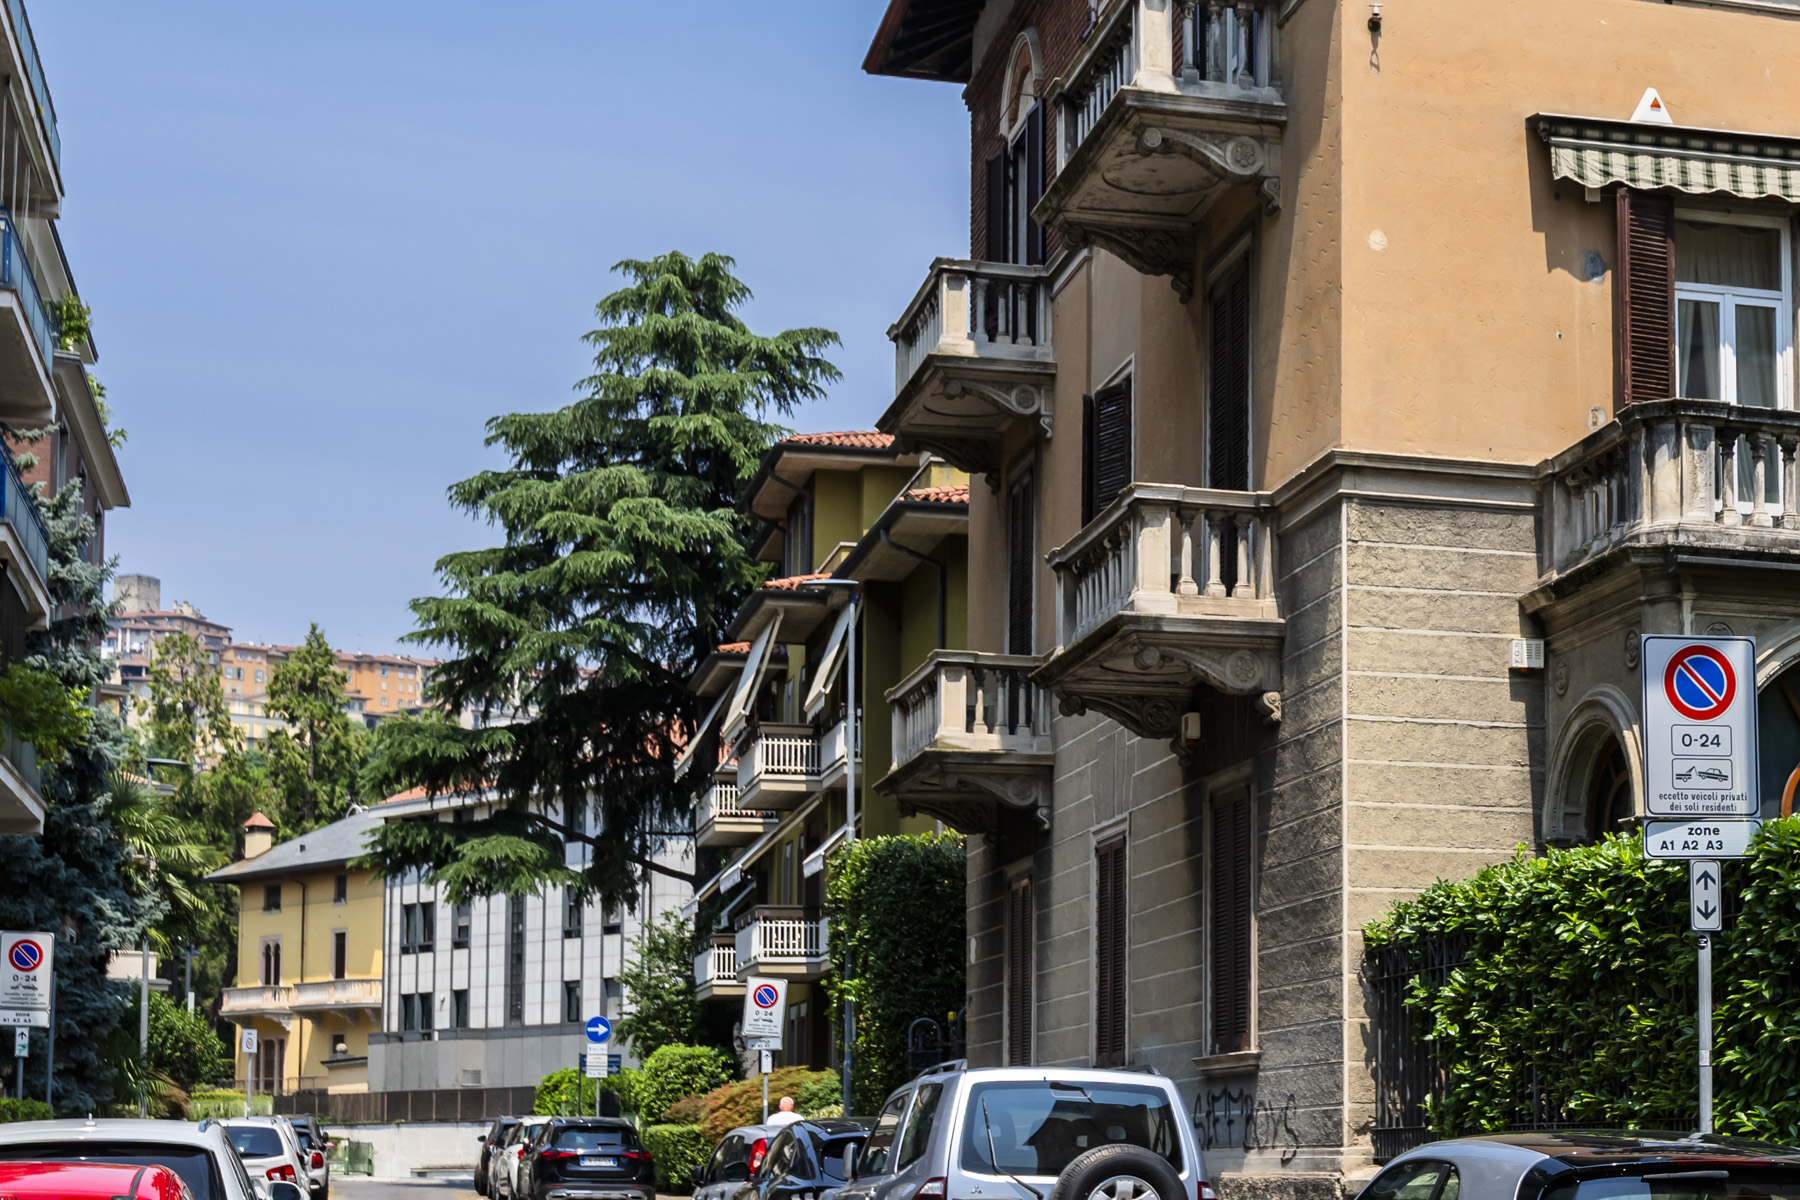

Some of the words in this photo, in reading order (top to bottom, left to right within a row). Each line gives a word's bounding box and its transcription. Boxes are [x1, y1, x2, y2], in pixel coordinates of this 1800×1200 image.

[1682, 734, 1721, 747] 0-24
[1659, 792, 1689, 801] eccetto
[1691, 792, 1718, 801] veicoli
[1721, 792, 1748, 803] privati
[1669, 803, 1682, 812] dei
[1684, 803, 1699, 812] soli
[1702, 803, 1737, 812] residenti
[1688, 827, 1720, 836] zone
[1660, 840, 1675, 850] A1
[1682, 840, 1699, 850] A2
[1706, 840, 1723, 850] A3
